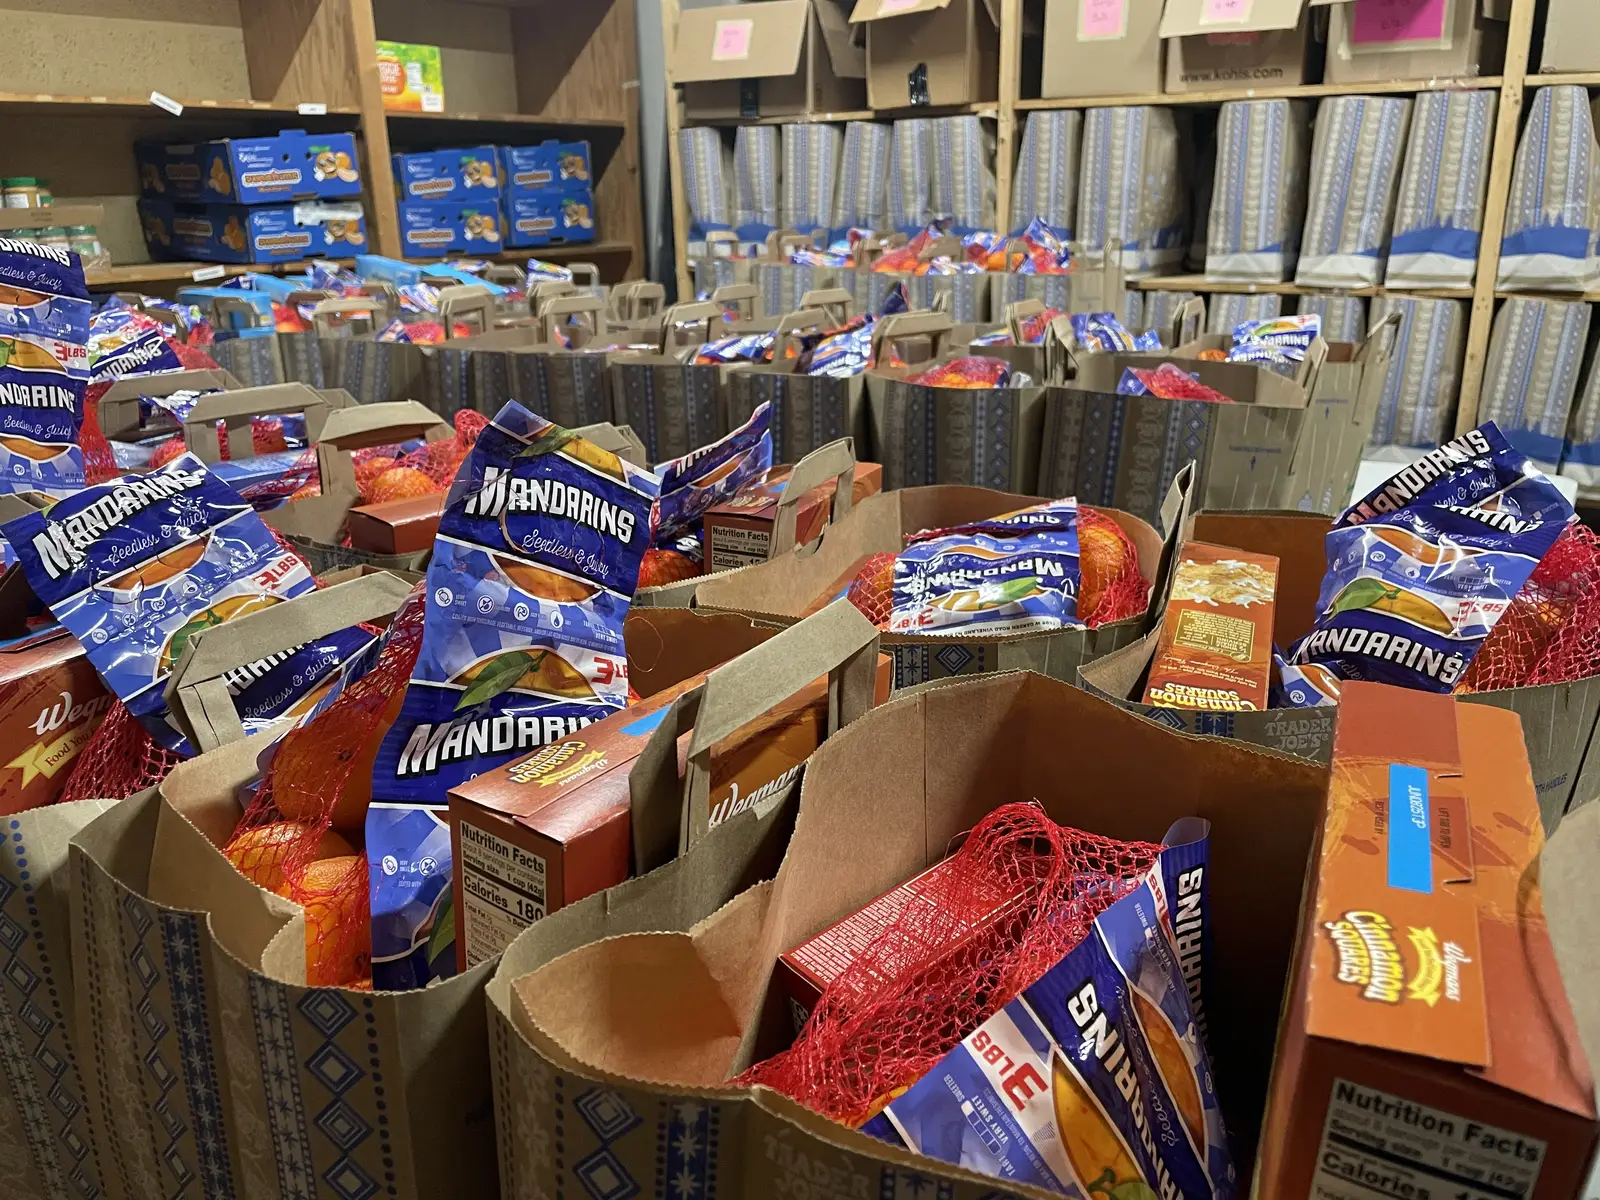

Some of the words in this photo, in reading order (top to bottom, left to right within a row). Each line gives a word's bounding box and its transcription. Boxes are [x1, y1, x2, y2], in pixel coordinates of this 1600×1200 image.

[0, 264, 25, 282] edless
[54, 343, 68, 361] 3
[67, 346, 87, 359] LBS
[4, 415, 34, 434] Seedless
[34, 424, 43, 435] &
[44, 418, 72, 438] Juicy
[1347, 429, 1491, 525] MANDARINS
[465, 466, 635, 544] MANDARINS
[32, 469, 206, 579] MANDARINS
[713, 527, 745, 539] Nutrition
[747, 531, 769, 542] Facts
[107, 533, 160, 567] Seedless
[161, 524, 172, 538] &
[523, 529, 574, 560] Seedless
[574, 549, 585, 565] &
[713, 555, 744, 566] Calories
[252, 571, 281, 592] 3
[271, 555, 298, 577] LBS
[963, 627, 994, 635] VINELAND
[1012, 623, 1034, 631] GARDEN
[593, 656, 614, 684] 3
[244, 687, 293, 719] Seedless
[293, 674, 303, 687] &
[1164, 683, 1240, 700] SQUARES
[1264, 717, 1332, 736] TRADER
[45, 742, 71, 767] Food
[508, 745, 562, 774] SQUARES
[510, 741, 587, 783] Cinnamon
[558, 759, 608, 787] Wegmans
[461, 822, 509, 858] Nutrition
[512, 847, 545, 874] Facts
[463, 850, 486, 871] Serving
[486, 863, 500, 875] size
[507, 872, 511, 881] 1
[512, 877, 526, 888] cup
[464, 875, 508, 908] Calories
[517, 899, 544, 920] 180
[1149, 873, 1168, 914] LBS
[465, 902, 477, 914] Total
[477, 908, 486, 919] Fat
[1324, 921, 1370, 985] SQUARES
[1345, 910, 1404, 1002] Cinnamon
[971, 1030, 1015, 1077] LBS
[943, 1073, 965, 1103] SWEETER
[1002, 1062, 1049, 1112] 3
[972, 1095, 994, 1124] SWEET
[1336, 1081, 1455, 1136] Nutrition
[1464, 1122, 1539, 1162] Facts
[991, 1123, 1009, 1145] VERY
[999, 1154, 1016, 1176] TART
[1323, 1152, 1431, 1200] Calories
